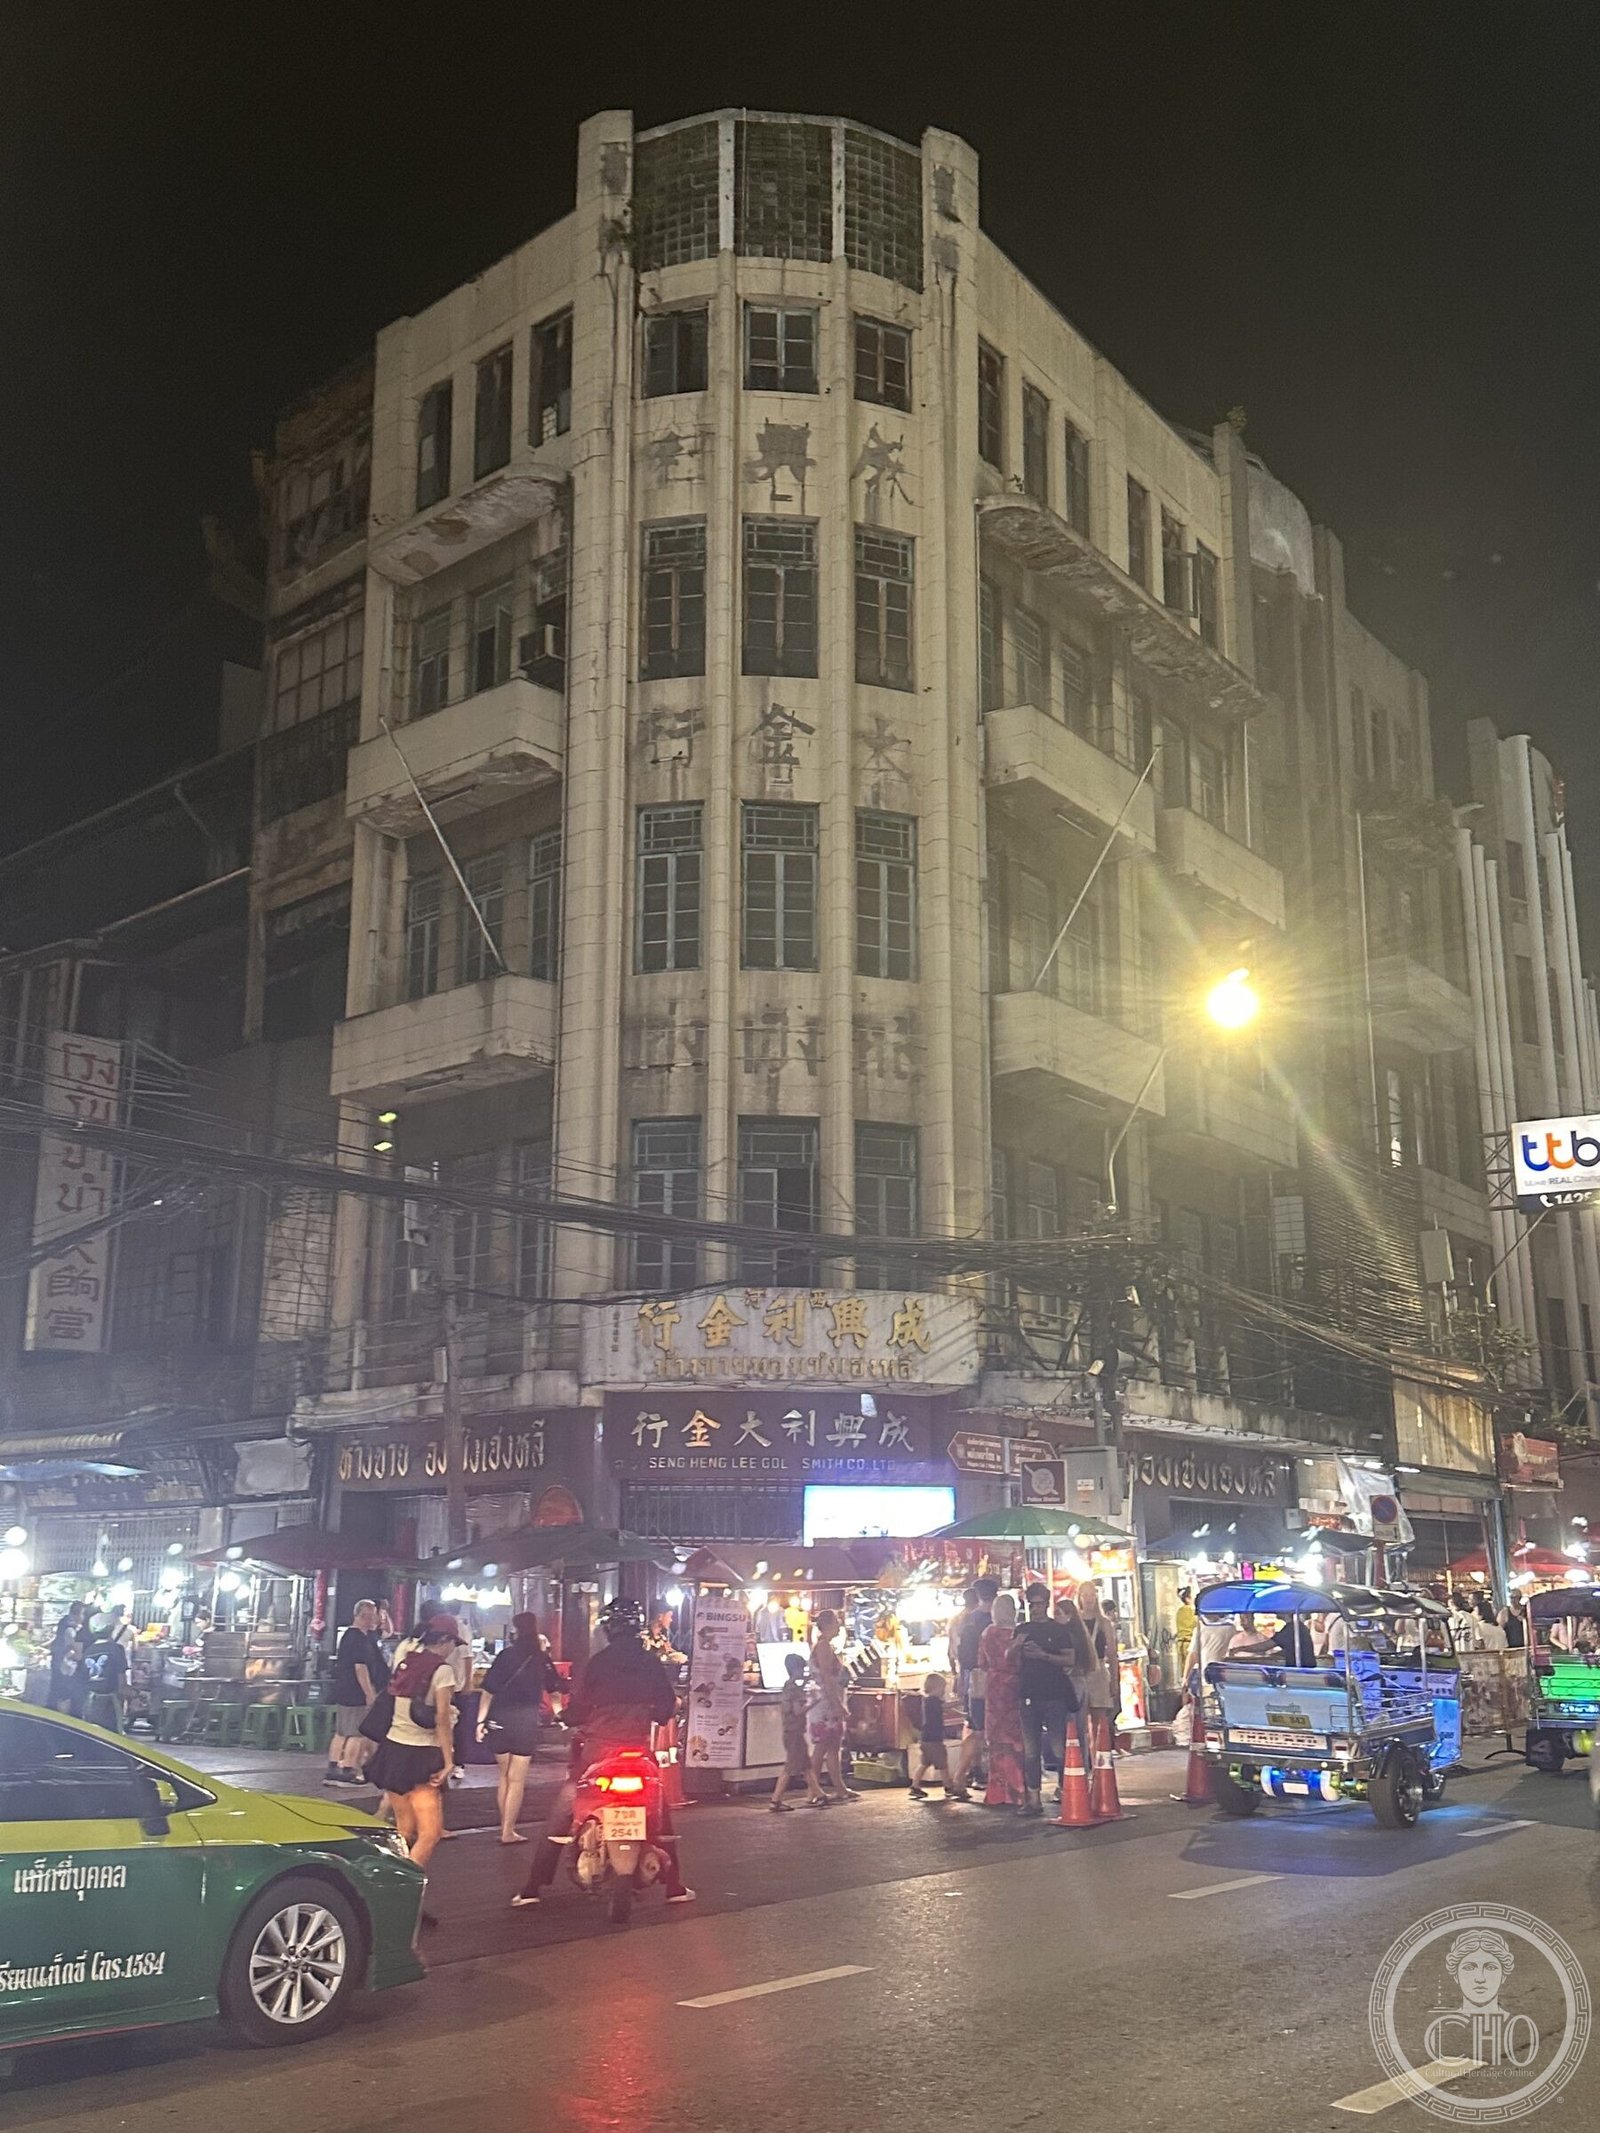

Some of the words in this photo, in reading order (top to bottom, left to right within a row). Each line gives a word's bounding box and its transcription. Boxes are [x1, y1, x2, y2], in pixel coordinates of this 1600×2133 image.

[1521, 1130, 1600, 1172] ttb
[649, 1457, 685, 1469] SENG
[689, 1457, 727, 1469] HENG
[731, 1457, 757, 1469] LEE
[801, 1457, 844, 1470] SMITH
[706, 1612, 747, 1622] BINGSU
[13, 1855, 127, 1902] แท็กซี่บุคคล
[90, 1951, 166, 1982] โทร.1584
